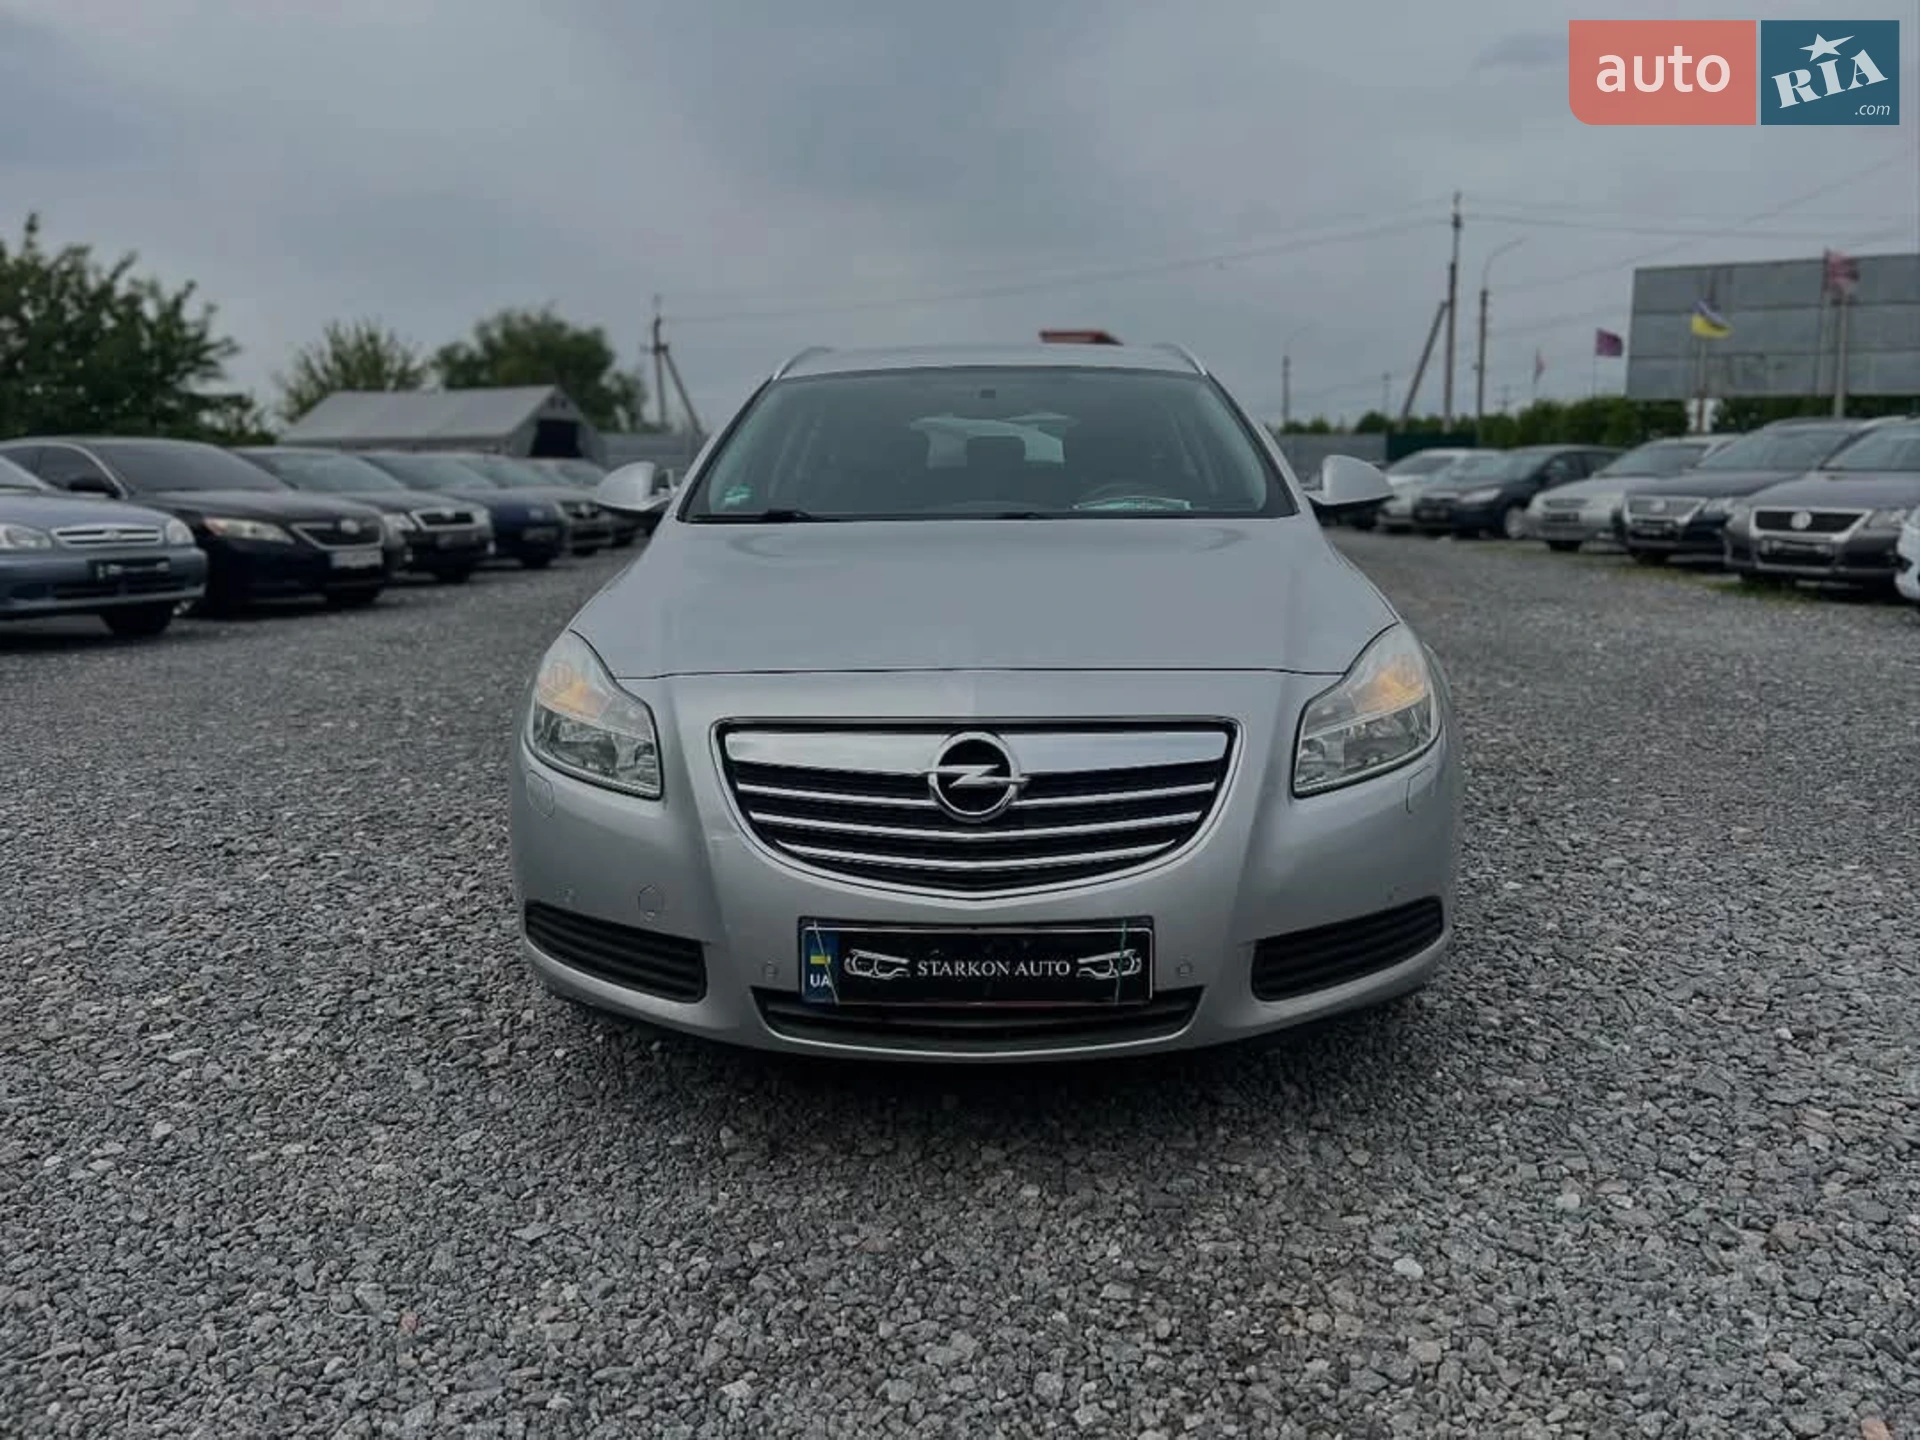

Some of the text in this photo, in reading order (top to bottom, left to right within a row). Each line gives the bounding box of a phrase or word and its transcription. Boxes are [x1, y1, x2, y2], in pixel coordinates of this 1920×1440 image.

[917, 959, 1071, 977] STARKON AUTO
[809, 973, 832, 988] UA
